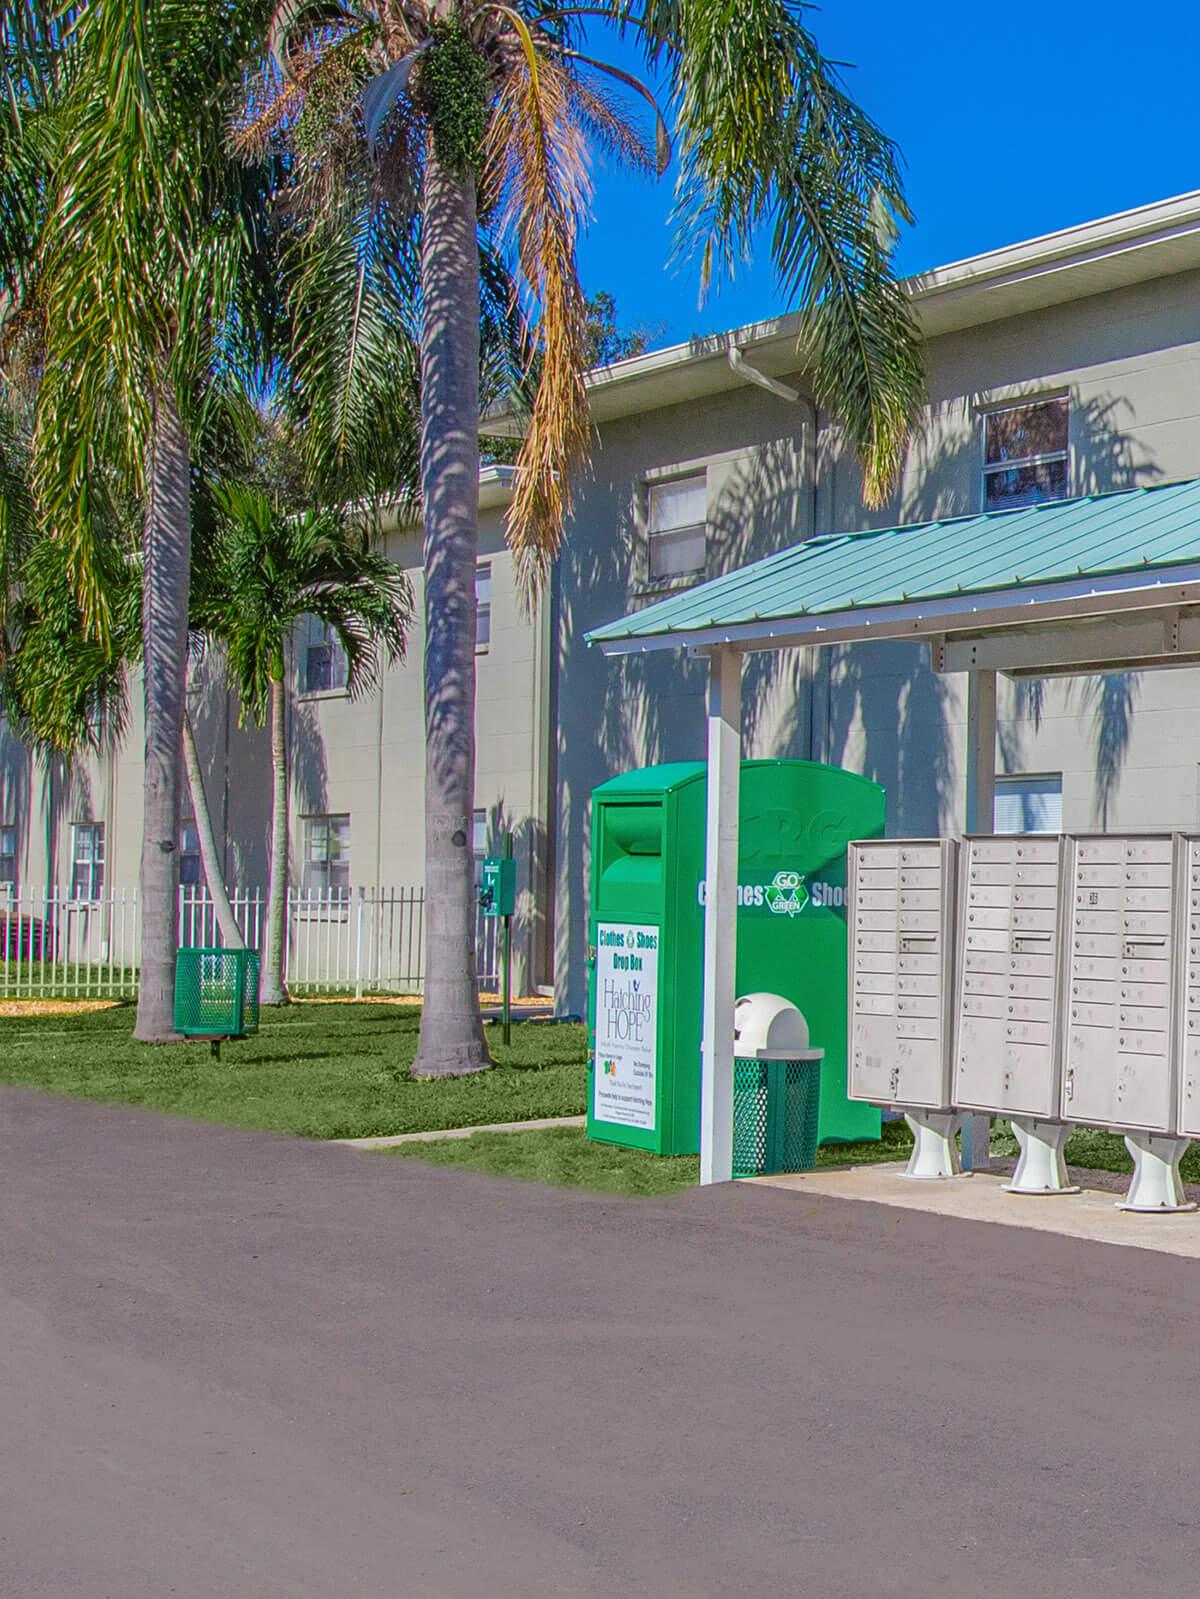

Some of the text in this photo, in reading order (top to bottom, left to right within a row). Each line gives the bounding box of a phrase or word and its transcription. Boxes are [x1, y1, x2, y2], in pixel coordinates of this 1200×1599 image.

[776, 874, 800, 887] GO
[772, 900, 801, 911] GREEN
[600, 929, 658, 950] Clothes Shoes
[613, 952, 643, 972] Drop Box
[604, 978, 652, 1023] Hatching
[607, 1008, 643, 1042] HOPE
